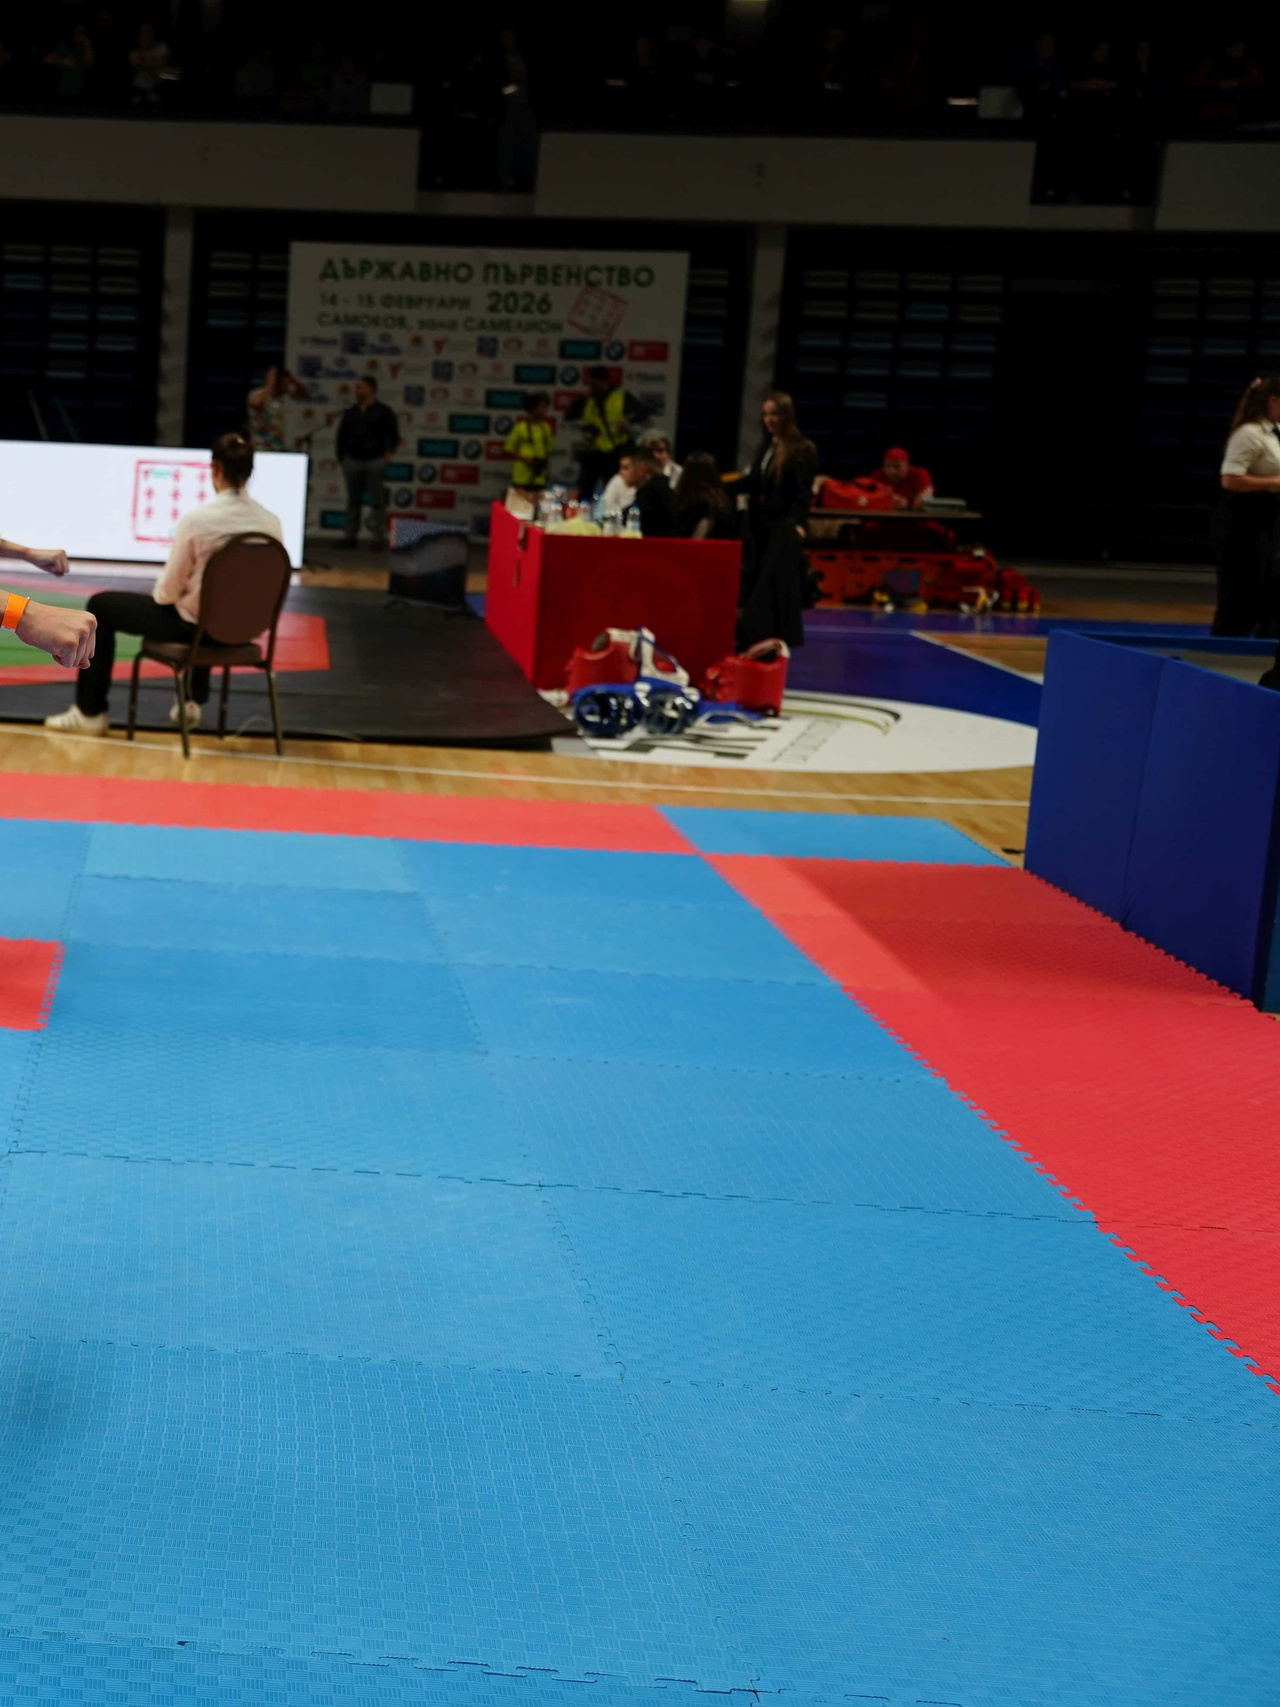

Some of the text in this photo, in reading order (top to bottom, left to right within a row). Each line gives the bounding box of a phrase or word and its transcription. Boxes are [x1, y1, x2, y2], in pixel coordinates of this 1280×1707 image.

[319, 258, 655, 288] ДЪРЖАВНО ПЪРВЕНСТВО
[320, 291, 338, 307] 14
[357, 293, 374, 308] 15
[380, 293, 471, 310] ФЕВРУАРИ
[486, 290, 553, 315] 2026
